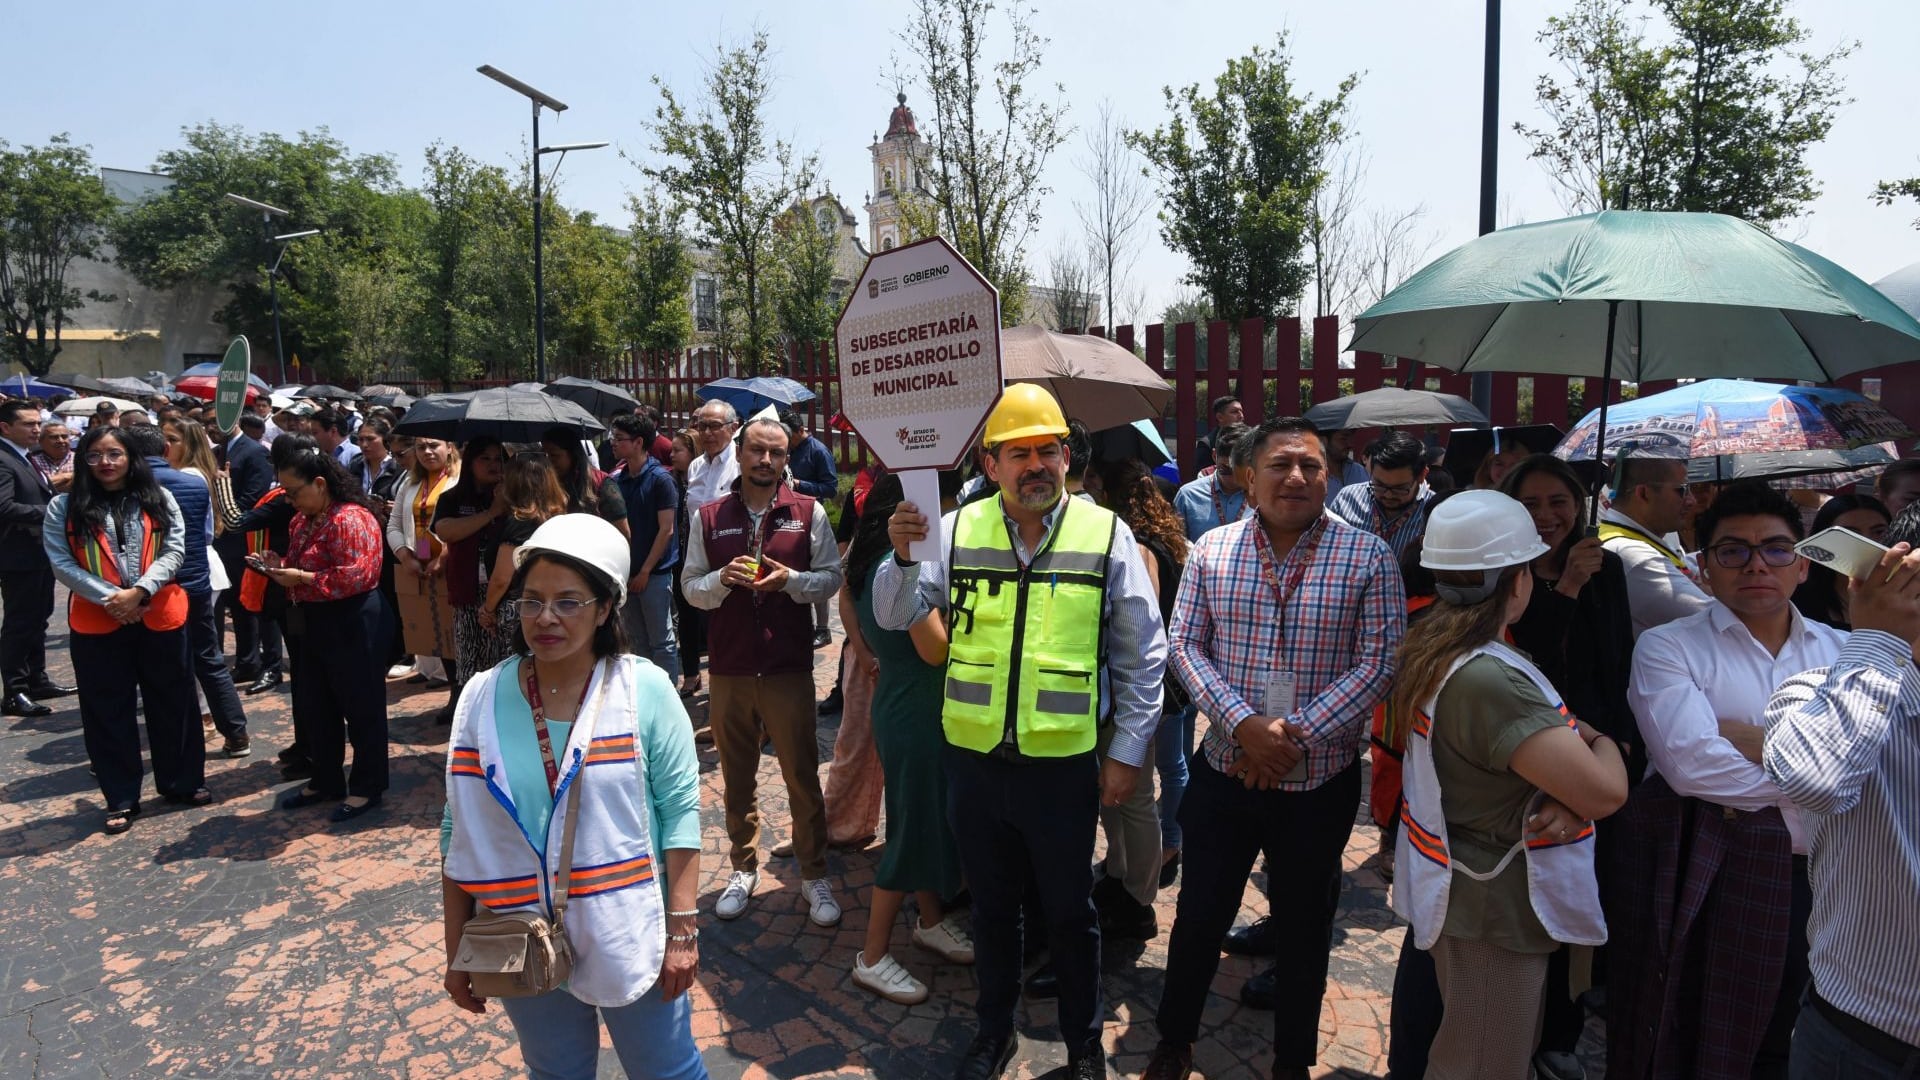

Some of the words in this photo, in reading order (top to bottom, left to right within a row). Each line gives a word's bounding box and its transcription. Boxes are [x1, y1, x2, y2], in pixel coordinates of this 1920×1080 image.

[903, 265, 949, 284] GOBIERNO
[850, 312, 979, 353] SUBSECRETARÍA
[851, 360, 871, 376] DE
[874, 340, 981, 373] DESARROLLO
[873, 371, 959, 397] MUNICIPAL
[1703, 438, 1762, 450] FIRENZE
